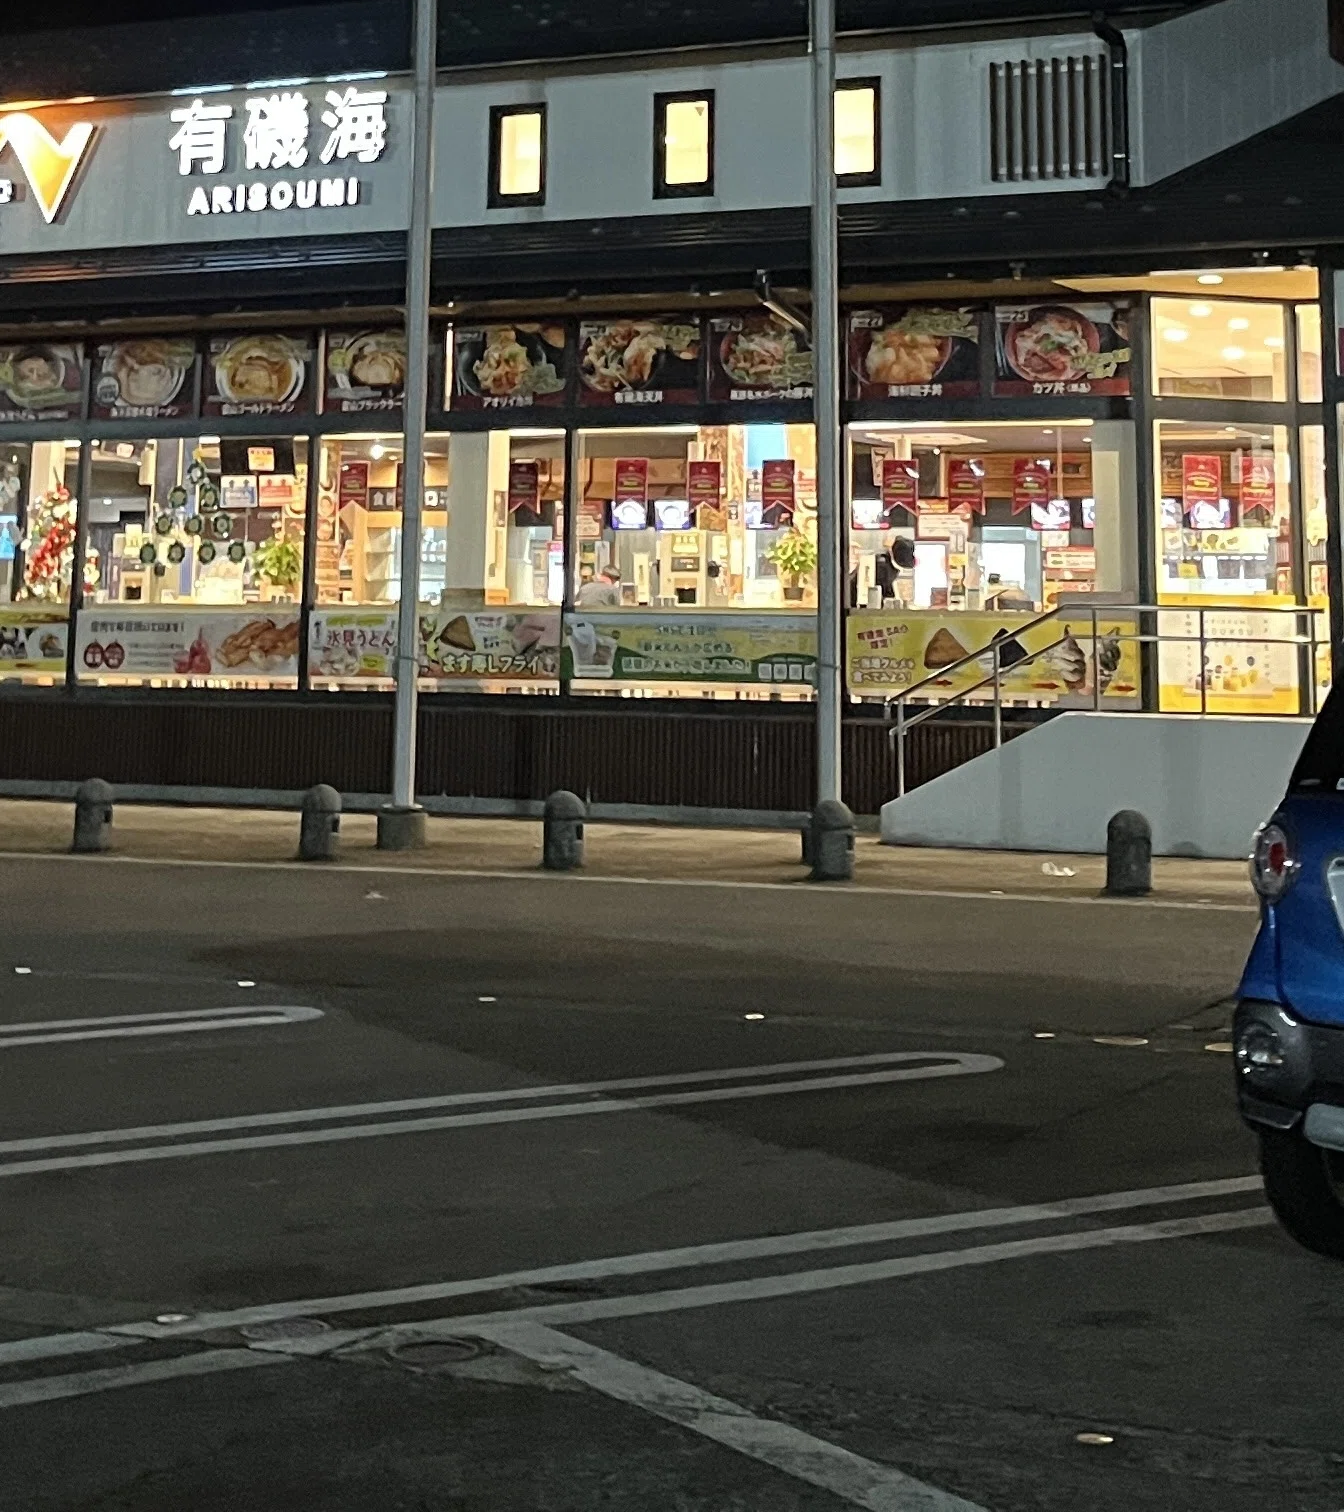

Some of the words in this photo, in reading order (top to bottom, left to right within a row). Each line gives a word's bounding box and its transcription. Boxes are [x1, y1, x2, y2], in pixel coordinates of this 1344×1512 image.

[169, 86, 388, 175] 有磯海
[187, 178, 360, 215] ARISOUMI
[328, 629, 395, 647] 氷見うどん
